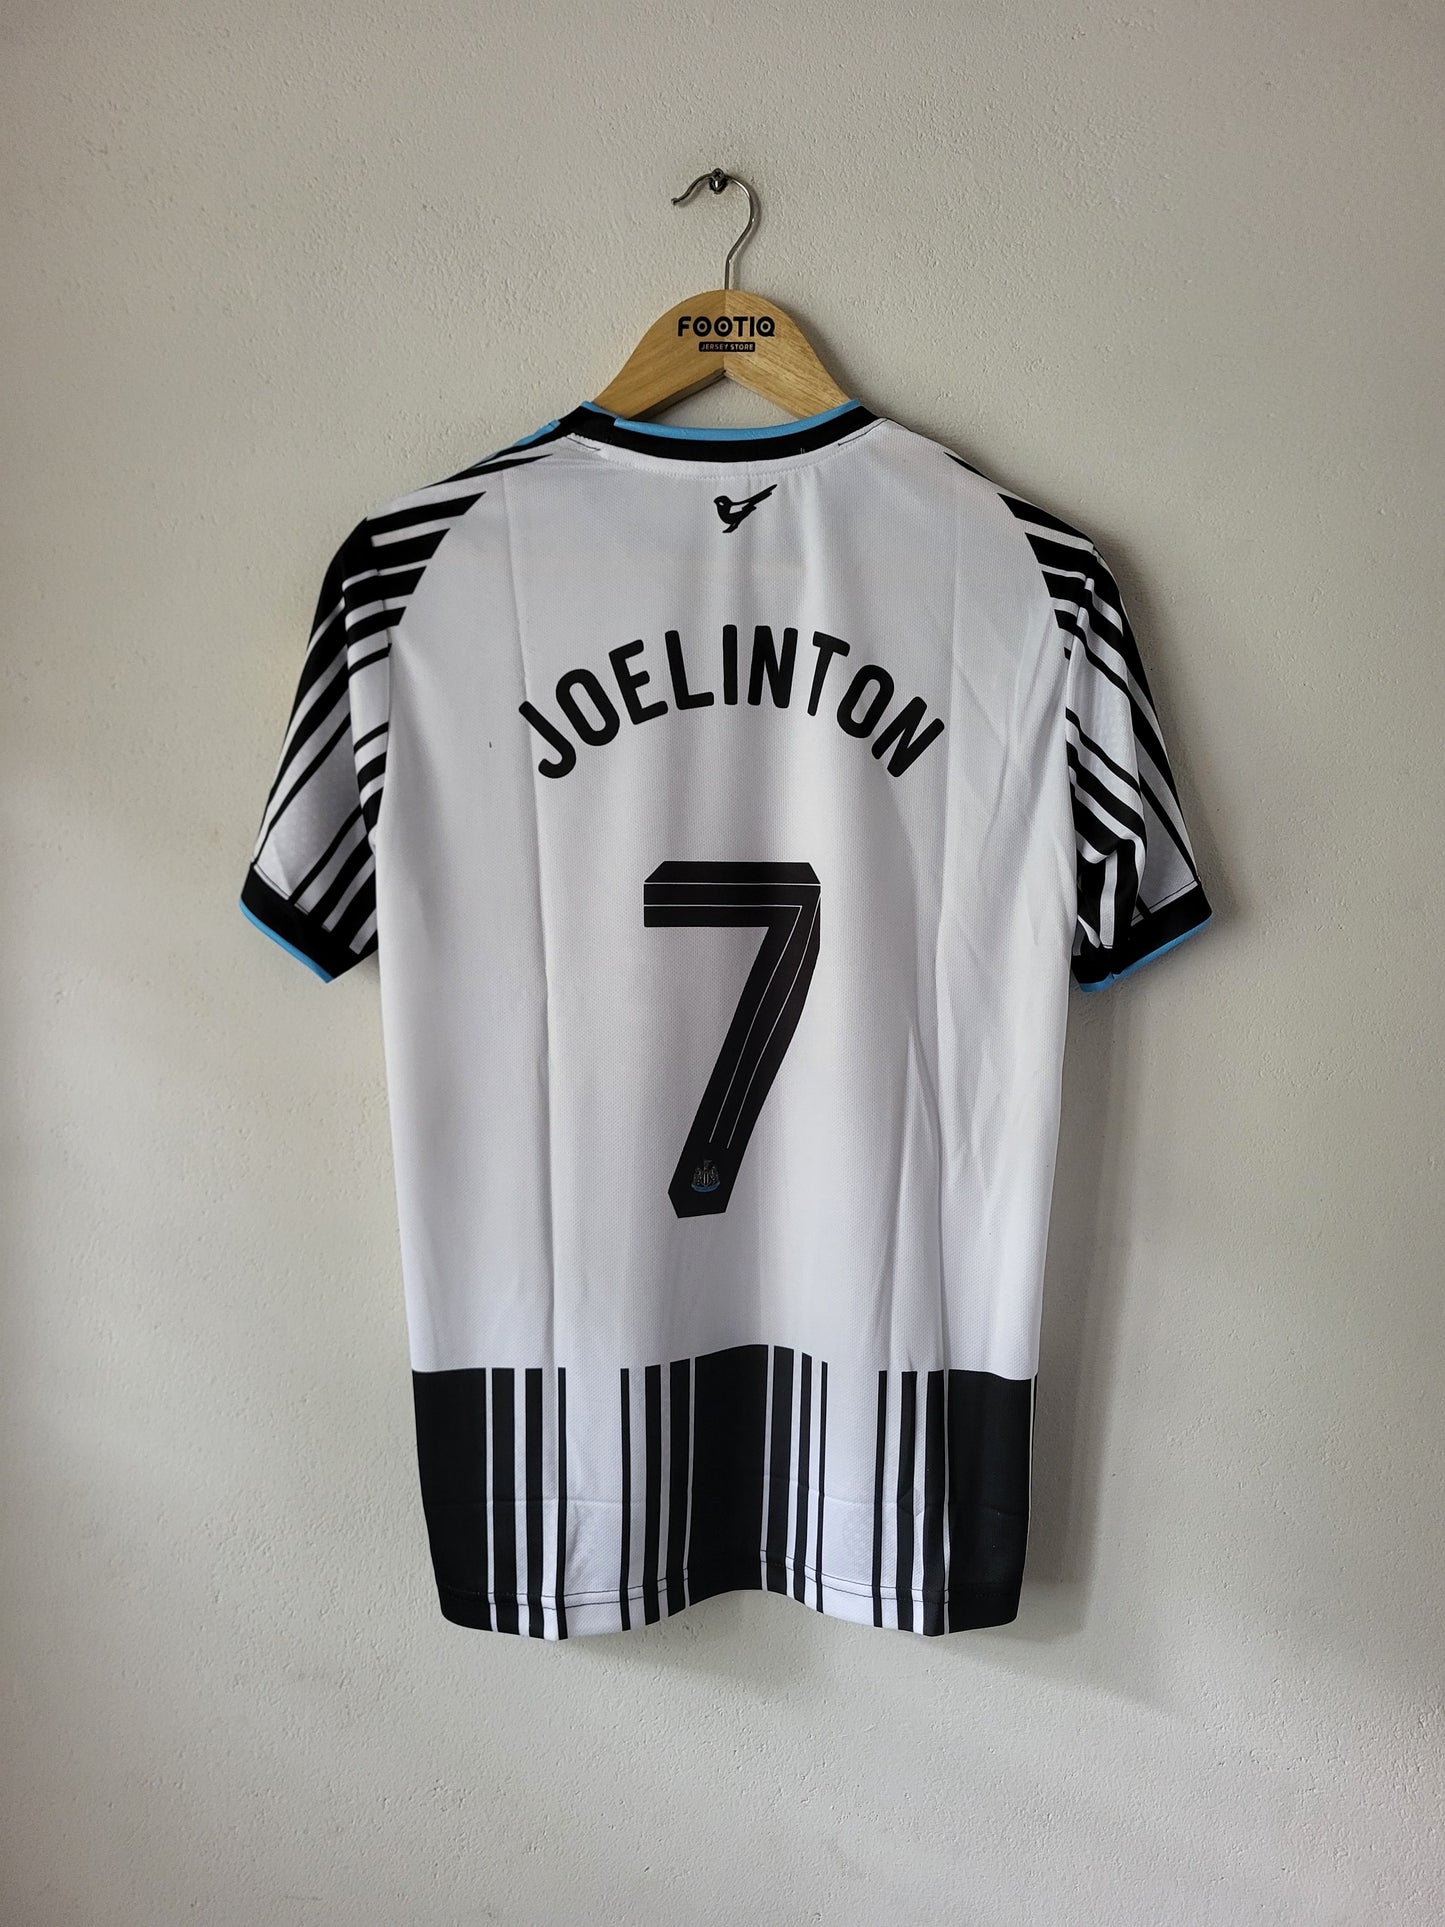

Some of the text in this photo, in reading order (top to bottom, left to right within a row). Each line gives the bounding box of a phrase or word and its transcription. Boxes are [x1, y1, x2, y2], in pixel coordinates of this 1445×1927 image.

[678, 316, 775, 337] FOOTIQ
[701, 343, 754, 351] JERSEY STORE
[519, 624, 945, 779] JOELINTON
[644, 861, 820, 1218] 7
